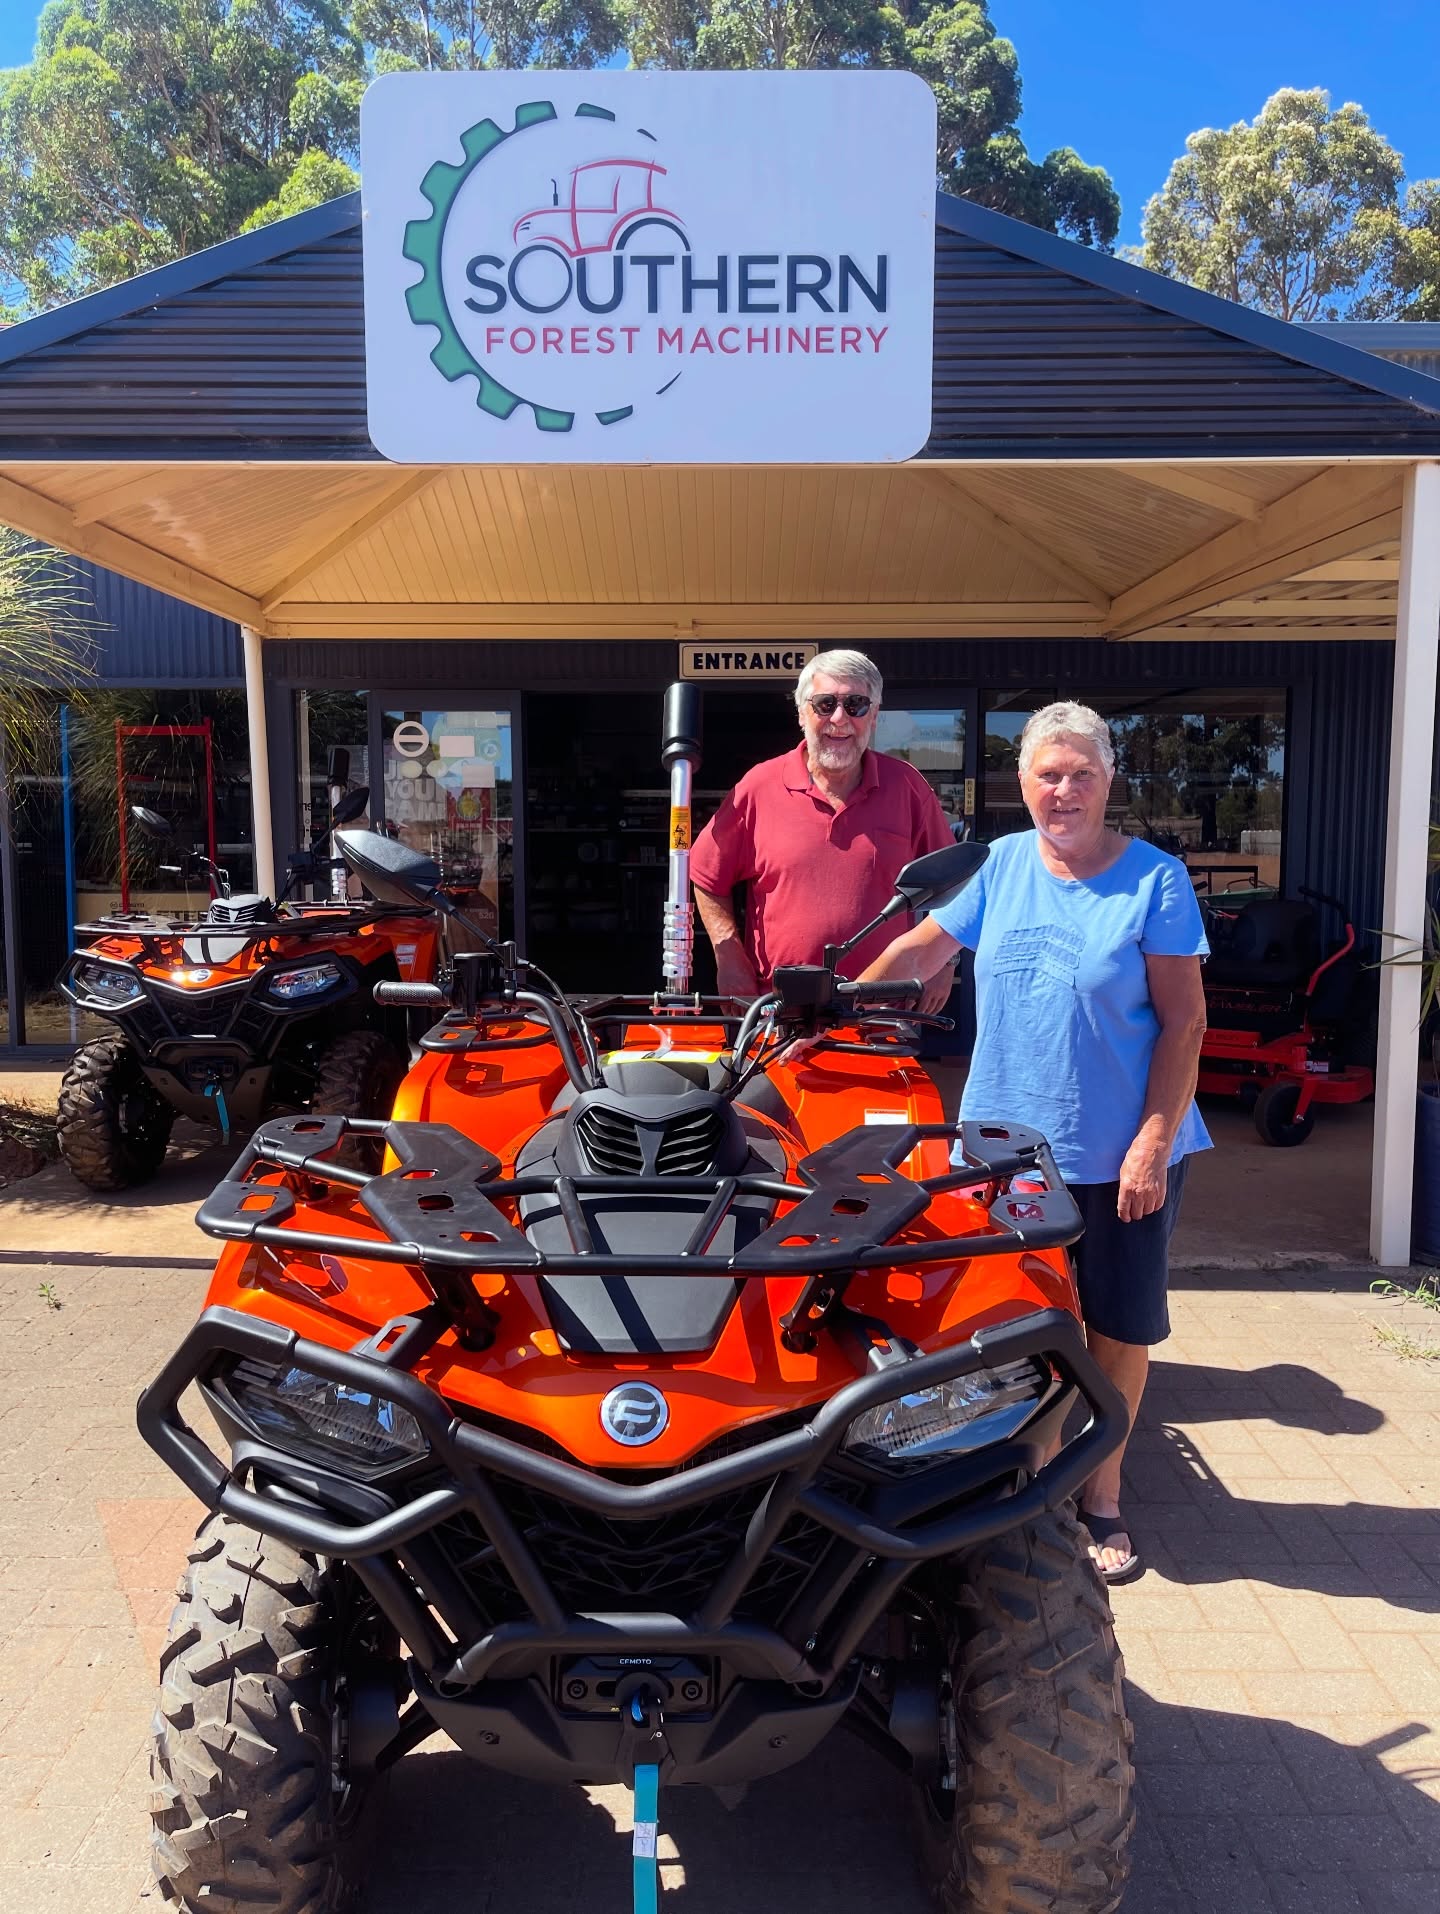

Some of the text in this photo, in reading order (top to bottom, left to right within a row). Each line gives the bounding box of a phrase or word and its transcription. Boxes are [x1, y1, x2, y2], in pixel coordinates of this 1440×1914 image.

[464, 246, 888, 314] SOUTHERN
[486, 327, 889, 354] FOREST MACHINERY
[693, 652, 805, 670] ENTRANCE
